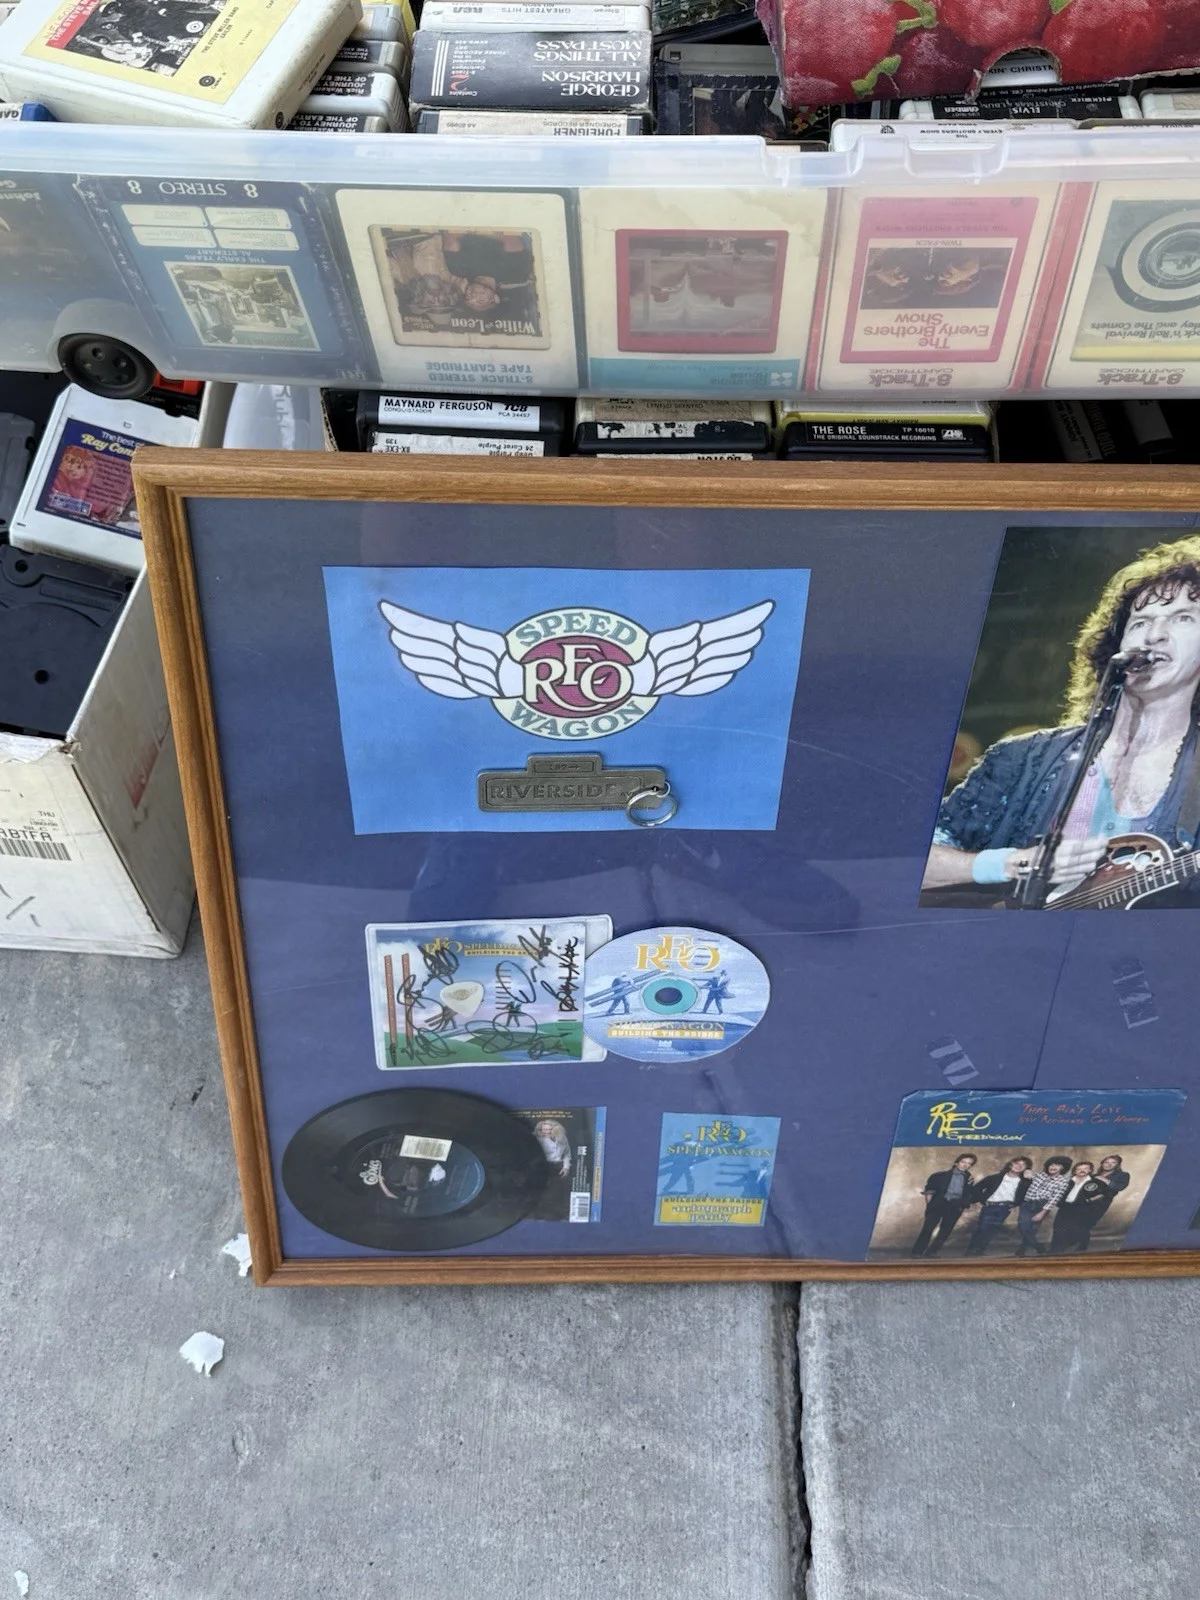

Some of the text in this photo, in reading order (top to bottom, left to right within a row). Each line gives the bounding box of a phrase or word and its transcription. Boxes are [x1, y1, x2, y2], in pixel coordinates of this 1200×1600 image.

[51, 4, 84, 41] THE STEVE
[208, 33, 220, 46] STEVE
[217, 18, 231, 32] MILLER
[229, 6, 239, 20] BAND
[536, 40, 643, 52] MUST PASS
[534, 50, 641, 64] ALL THINGS
[1010, 65, 1054, 73] CHRISTM
[450, 74, 470, 91] 2
[542, 70, 641, 83] HARRISON
[560, 82, 641, 97] GEORGE
[554, 127, 621, 136] FOREIGNER
[127, 180, 259, 199] 8 STEREO 8
[893, 313, 944, 325] Show
[451, 318, 536, 334] Leon Willie
[863, 324, 989, 338] Everly Brothers
[1090, 322, 1178, 331] and The Comets
[1105, 330, 1147, 340] Revival
[1148, 330, 1170, 340] Roll
[918, 337, 950, 349] The
[425, 362, 533, 373] TAPE CARTRIDGE
[428, 373, 533, 383] 8-TRACK STEREO
[868, 374, 953, 388] 8-Track
[1096, 373, 1184, 386] 8-Track
[384, 398, 435, 409] MAYNARD
[439, 401, 493, 411] FERGUSON
[384, 406, 433, 414] CONQUISTADOR
[101, 431, 117, 442] The
[812, 426, 836, 435] THE
[838, 426, 867, 435] ROSE
[81, 433, 109, 451] Ray
[478, 442, 502, 450] Purple
[515, 611, 639, 649] SPEED
[524, 642, 634, 712] REO
[509, 700, 646, 738] WAGON
[490, 783, 618, 800] RIVERSIDE
[631, 933, 723, 973] REO
[662, 1030, 682, 1038] THE
[926, 1101, 992, 1138] REO
[698, 1119, 748, 1143] REO
[666, 1145, 772, 1157] SPEEDWAGON
[359, 1159, 383, 1186] Epic
[671, 1204, 752, 1215] autograph
[691, 1212, 731, 1222] party
